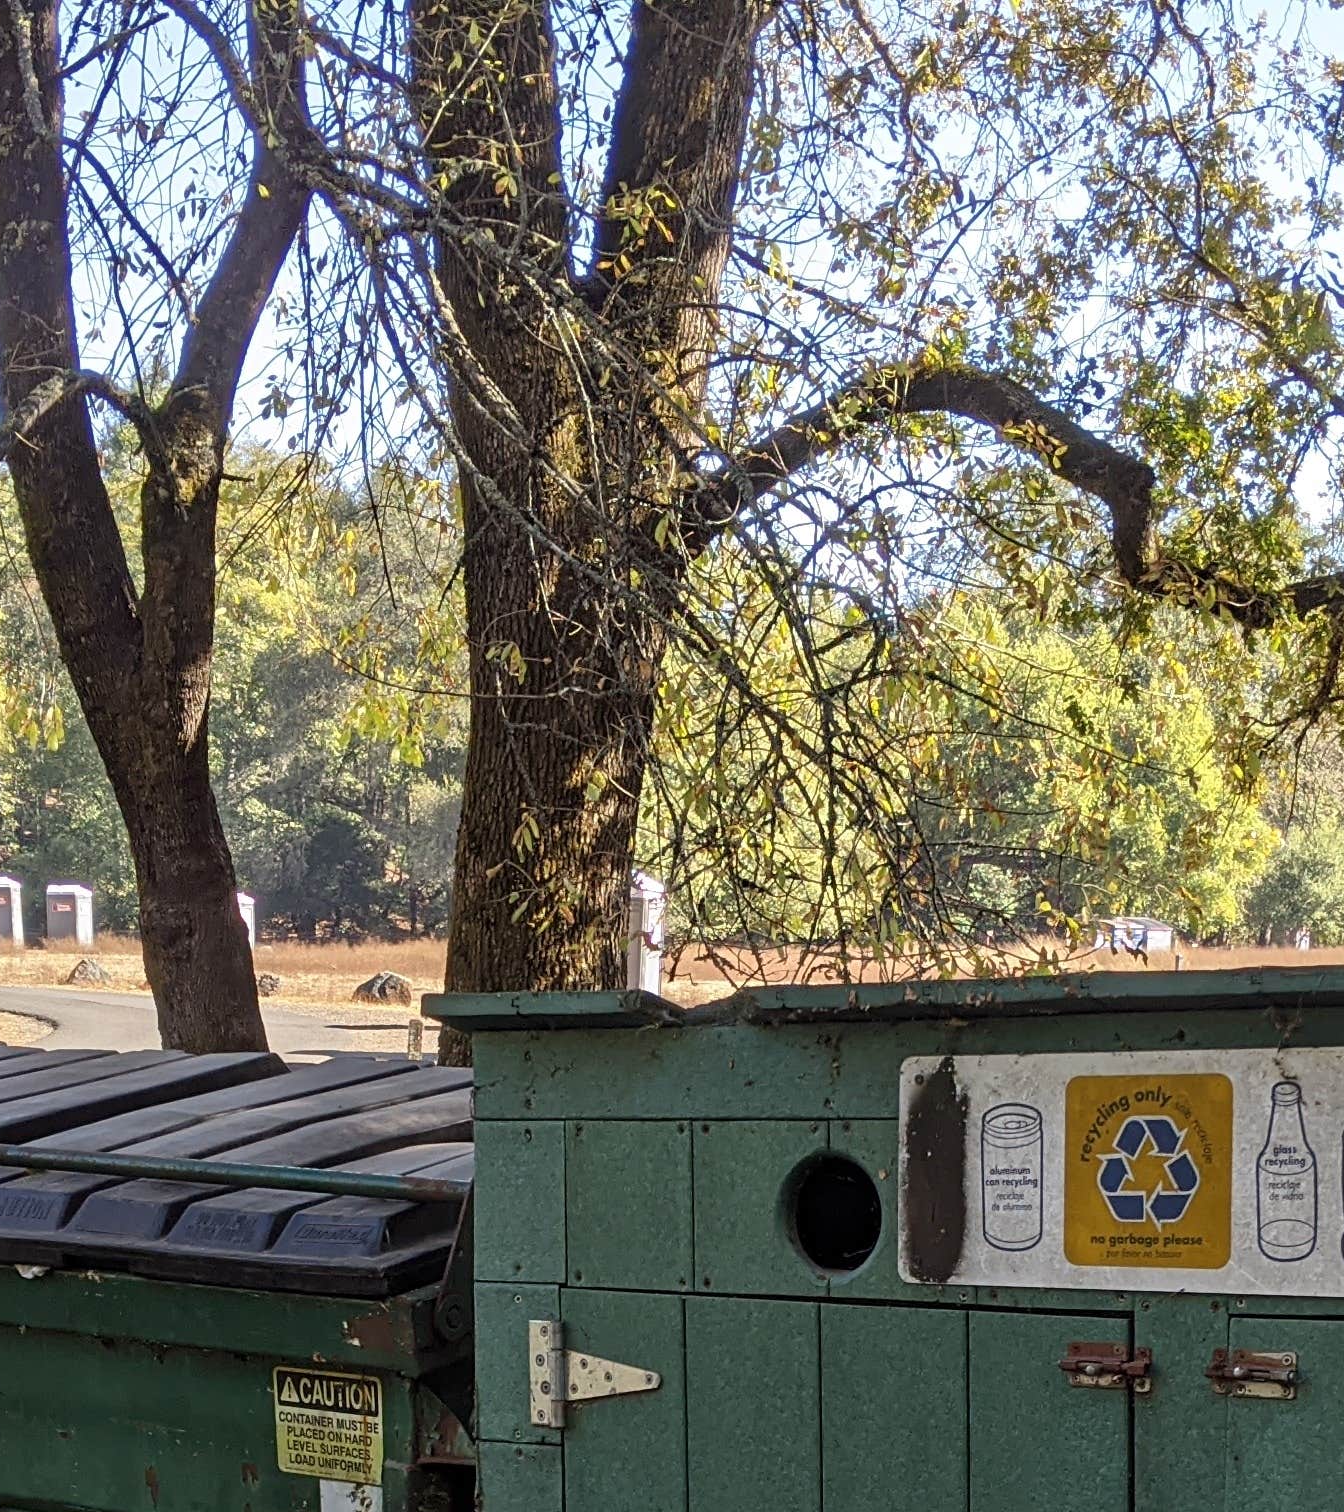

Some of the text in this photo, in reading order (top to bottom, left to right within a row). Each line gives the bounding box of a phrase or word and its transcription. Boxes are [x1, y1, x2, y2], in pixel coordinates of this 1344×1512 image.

[1080, 1085, 1172, 1162] recycling only
[1273, 1144, 1297, 1157] glass
[1264, 1156, 1306, 1168] recycling
[1002, 1176, 1038, 1188] recycling
[1090, 1233, 1204, 1247] no garbage please
[299, 1376, 376, 1411] CAUTION
[278, 1411, 379, 1434] CONTAINER MUST BE
[286, 1426, 372, 1447] PLACED ON HARD
[287, 1439, 317, 1454] LEVEL
[289, 1453, 316, 1467] LOAD
[318, 1456, 373, 1475] UNIFORMLY
